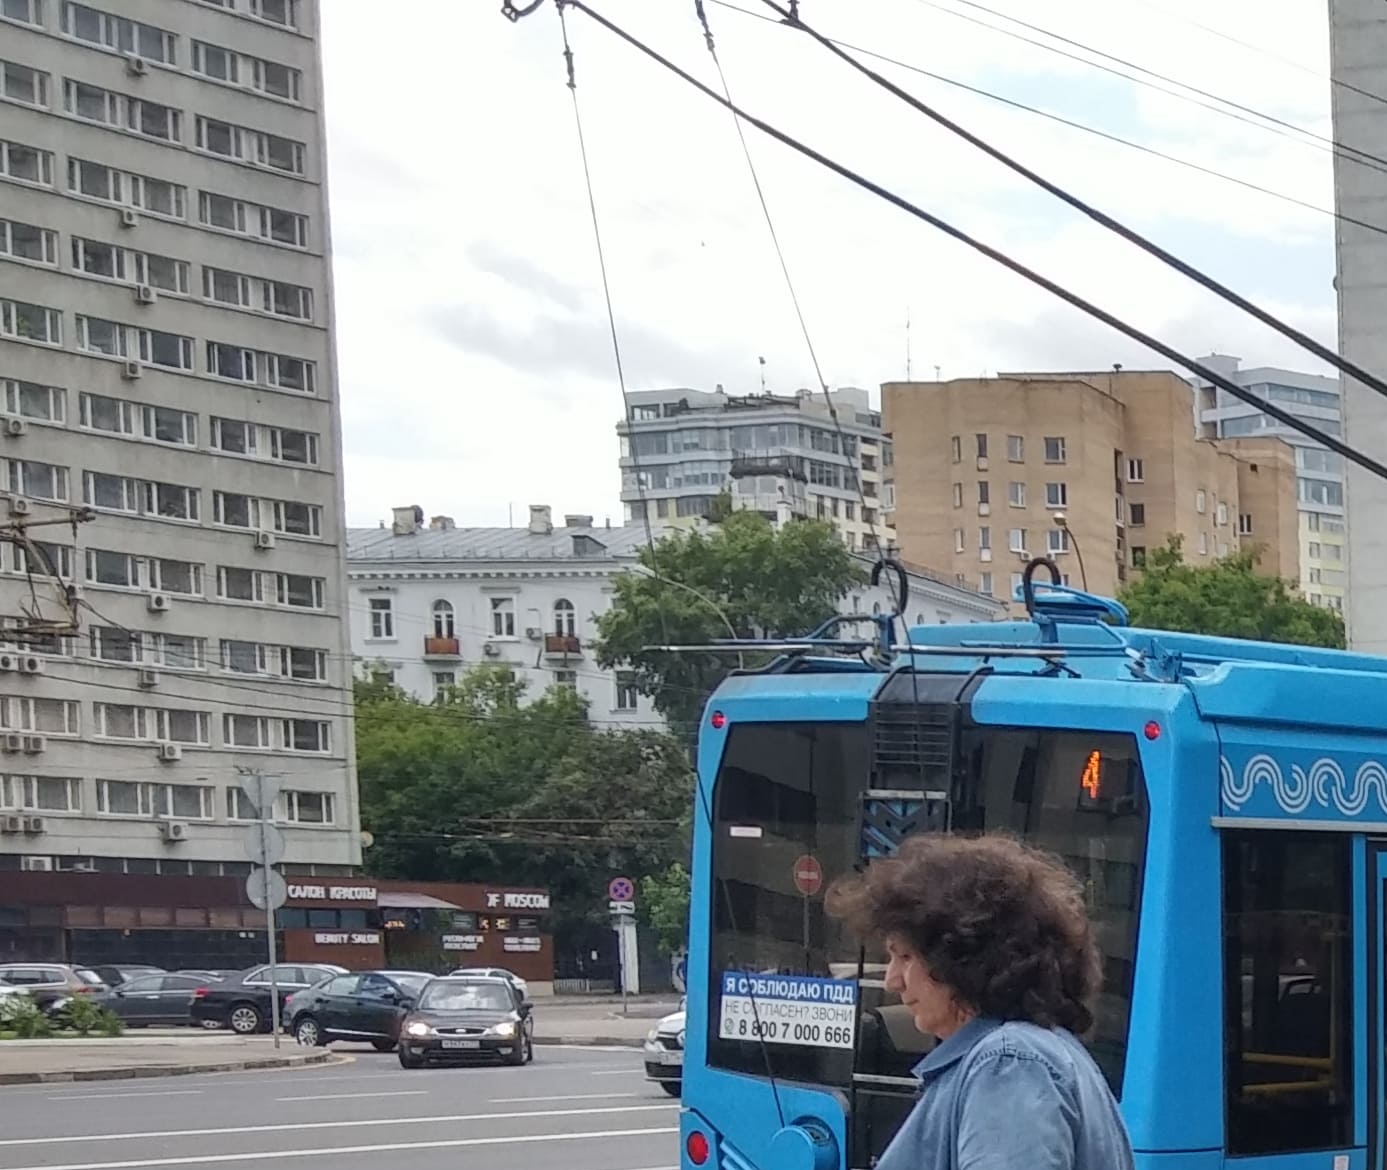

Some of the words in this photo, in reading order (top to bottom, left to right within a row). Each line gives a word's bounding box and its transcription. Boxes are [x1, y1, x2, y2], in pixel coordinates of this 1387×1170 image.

[1082, 751, 1100, 799] 4
[288, 885, 326, 899] САЛОН
[329, 886, 377, 900] КРАСОТЫ
[315, 933, 349, 944] BEAUTY
[351, 933, 380, 944] SALON
[726, 978, 735, 993] Я
[738, 978, 821, 999] СОБЛЮДАЮ
[823, 985, 854, 1004] ПДД
[725, 1000, 740, 1014] НЕ
[742, 1001, 810, 1018] СОГЛАСЕН?
[812, 1006, 853, 1022] ЗВОНИ
[739, 1019, 747, 1036] 8
[751, 1020, 777, 1038] 800
[782, 1022, 790, 1039] 7
[794, 1023, 820, 1041] 000
[824, 1026, 851, 1044] 666
